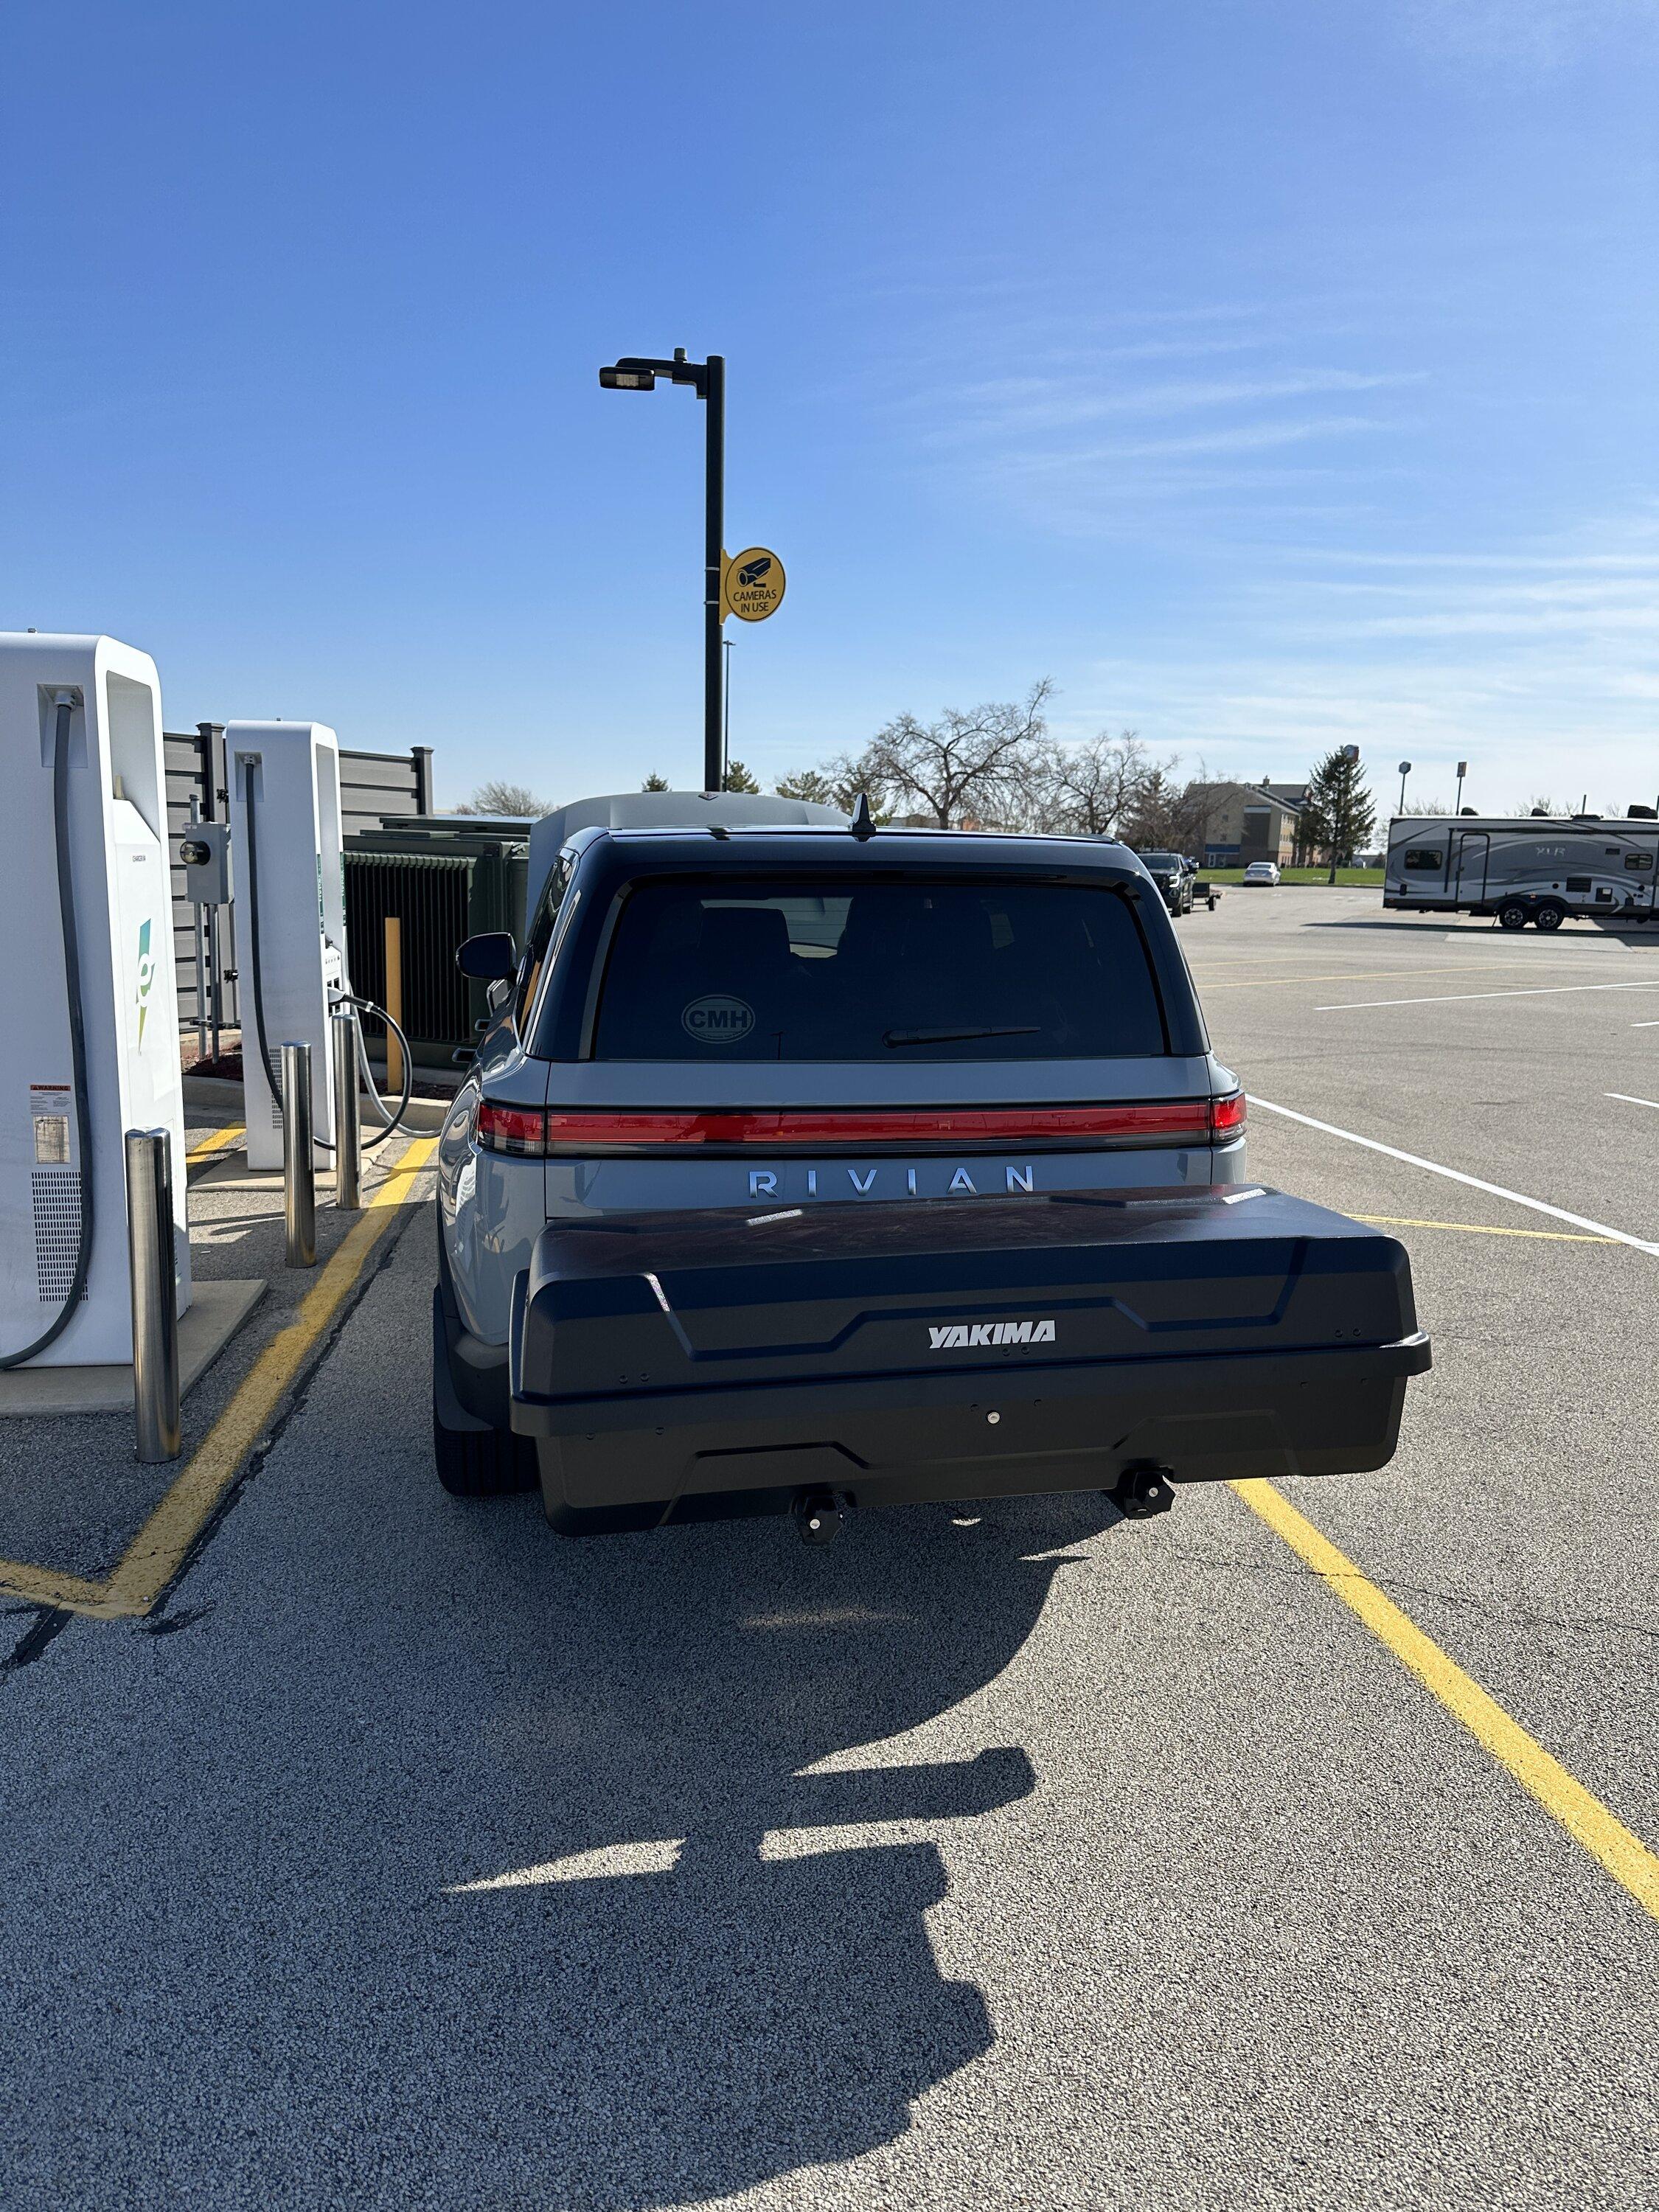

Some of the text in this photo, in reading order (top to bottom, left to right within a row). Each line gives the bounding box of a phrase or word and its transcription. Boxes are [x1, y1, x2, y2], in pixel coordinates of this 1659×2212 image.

[734, 589, 777, 602] CAMERAS
[741, 602, 769, 613] IN USE
[689, 1009, 748, 1029] CMH
[748, 1165, 1034, 1198] RIVIAN
[928, 1320, 1056, 1349] YAKIMA
